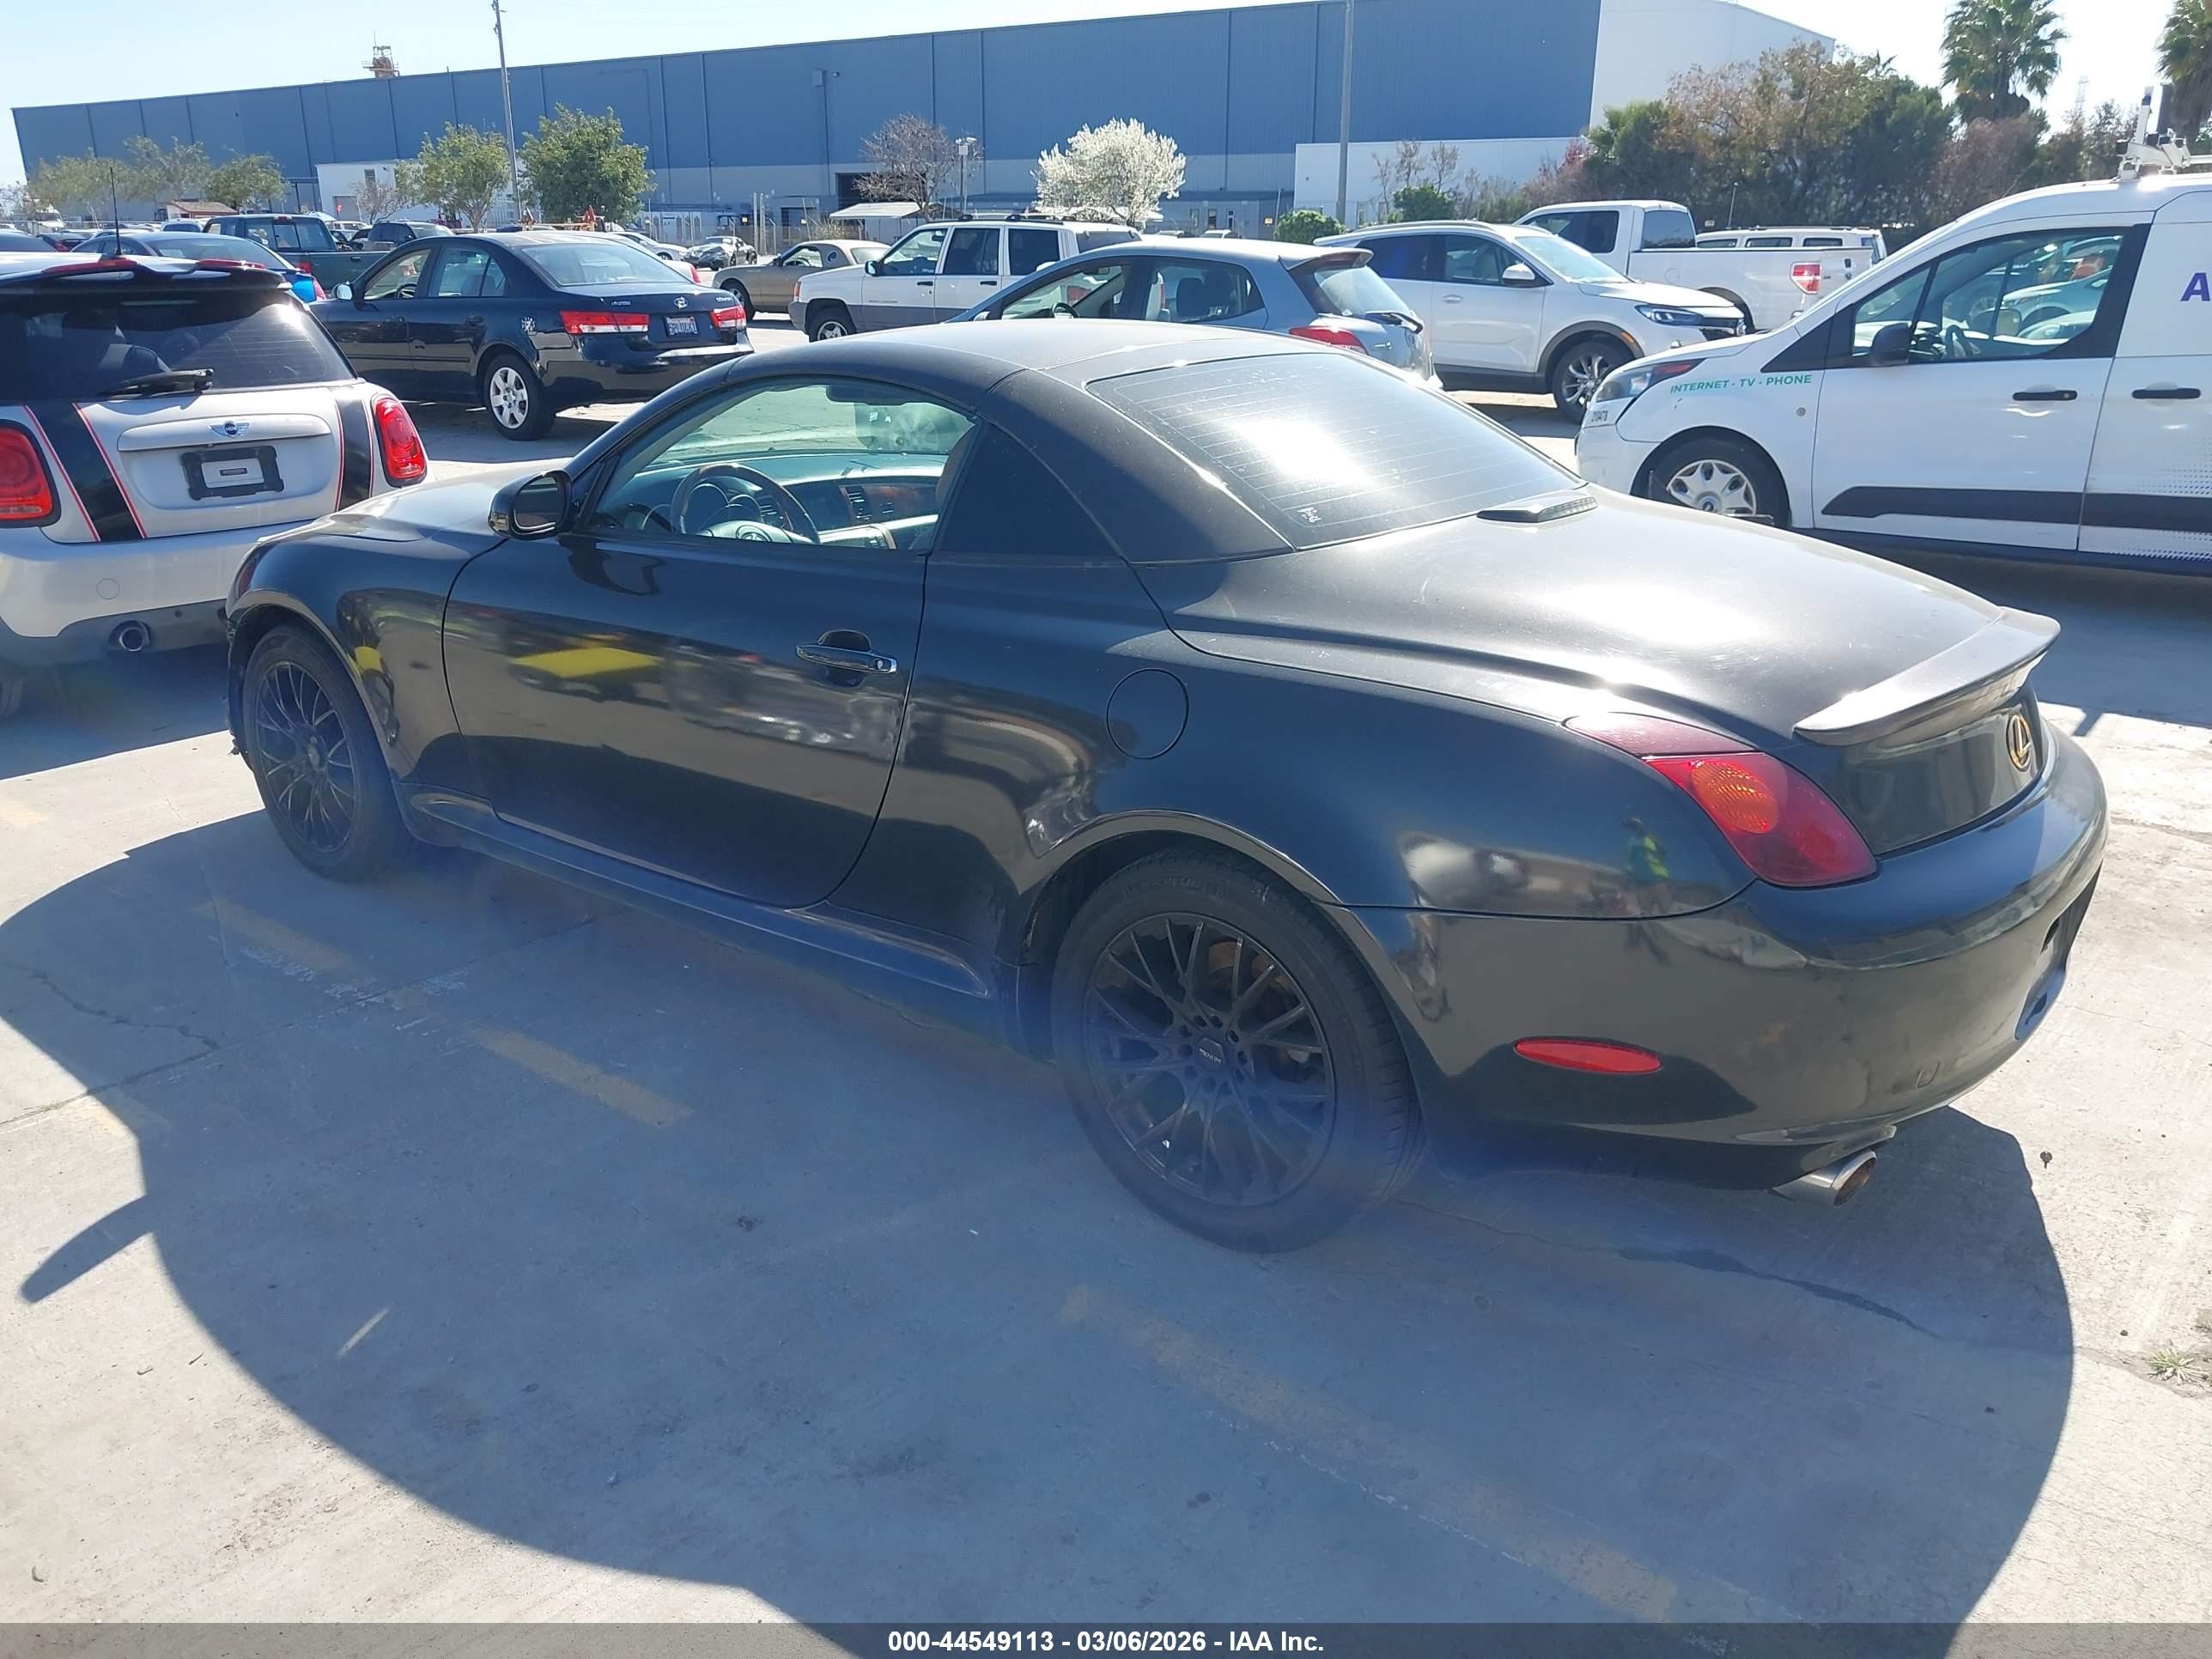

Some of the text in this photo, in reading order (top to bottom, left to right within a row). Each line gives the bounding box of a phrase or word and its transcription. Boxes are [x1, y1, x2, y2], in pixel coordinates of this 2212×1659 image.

[2180, 272, 2211, 301] A
[1669, 374, 1813, 394] INTERNET TV PHONE
